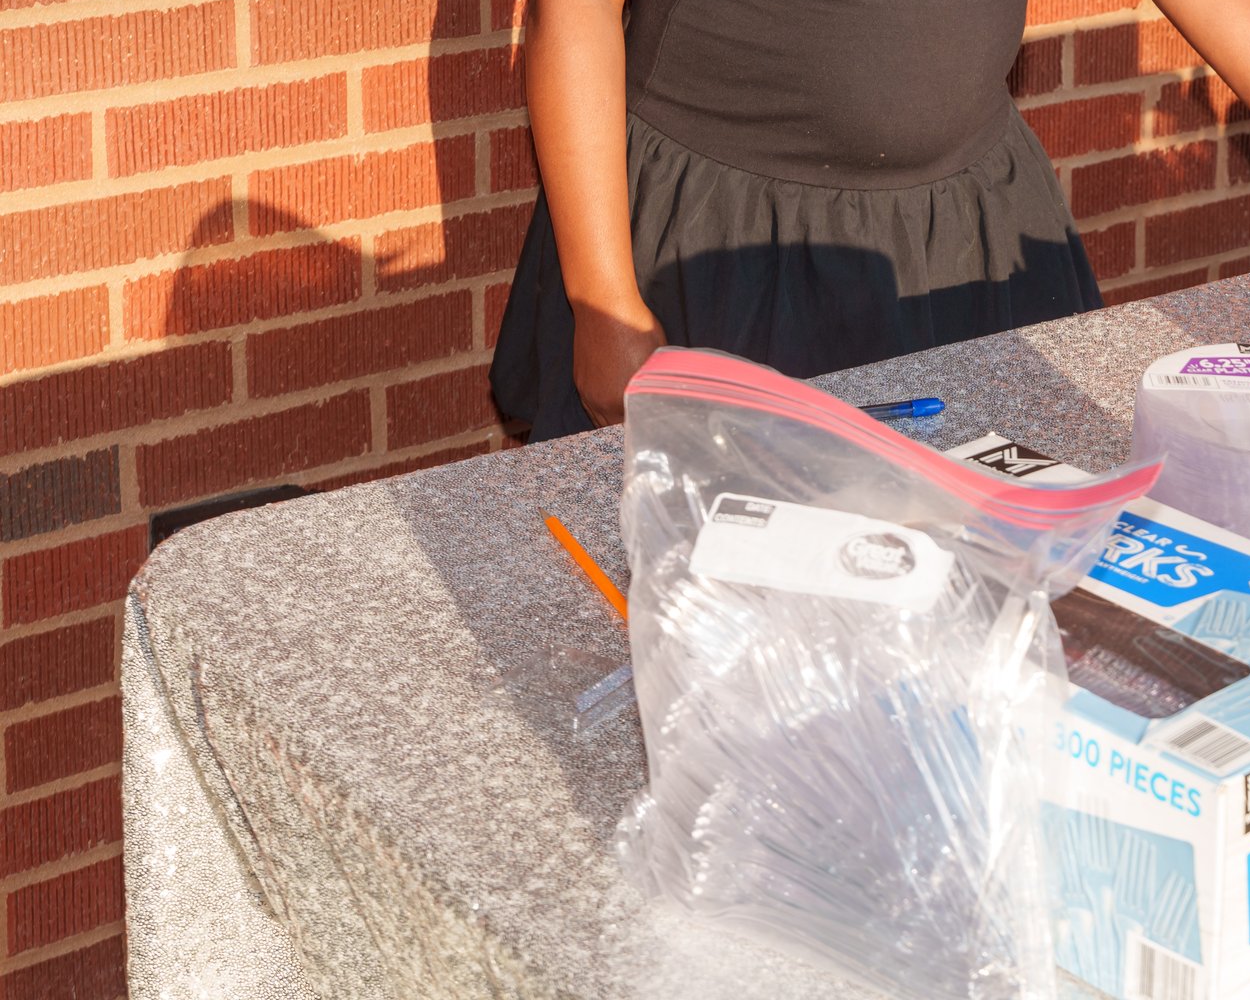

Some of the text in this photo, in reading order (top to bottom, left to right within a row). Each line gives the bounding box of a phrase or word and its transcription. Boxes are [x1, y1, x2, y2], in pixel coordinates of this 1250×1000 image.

[1103, 534, 1215, 589] RKS
[1111, 521, 1173, 547] CLEAR
[1055, 721, 1100, 767] 300
[1109, 749, 1201, 817] PIECES
